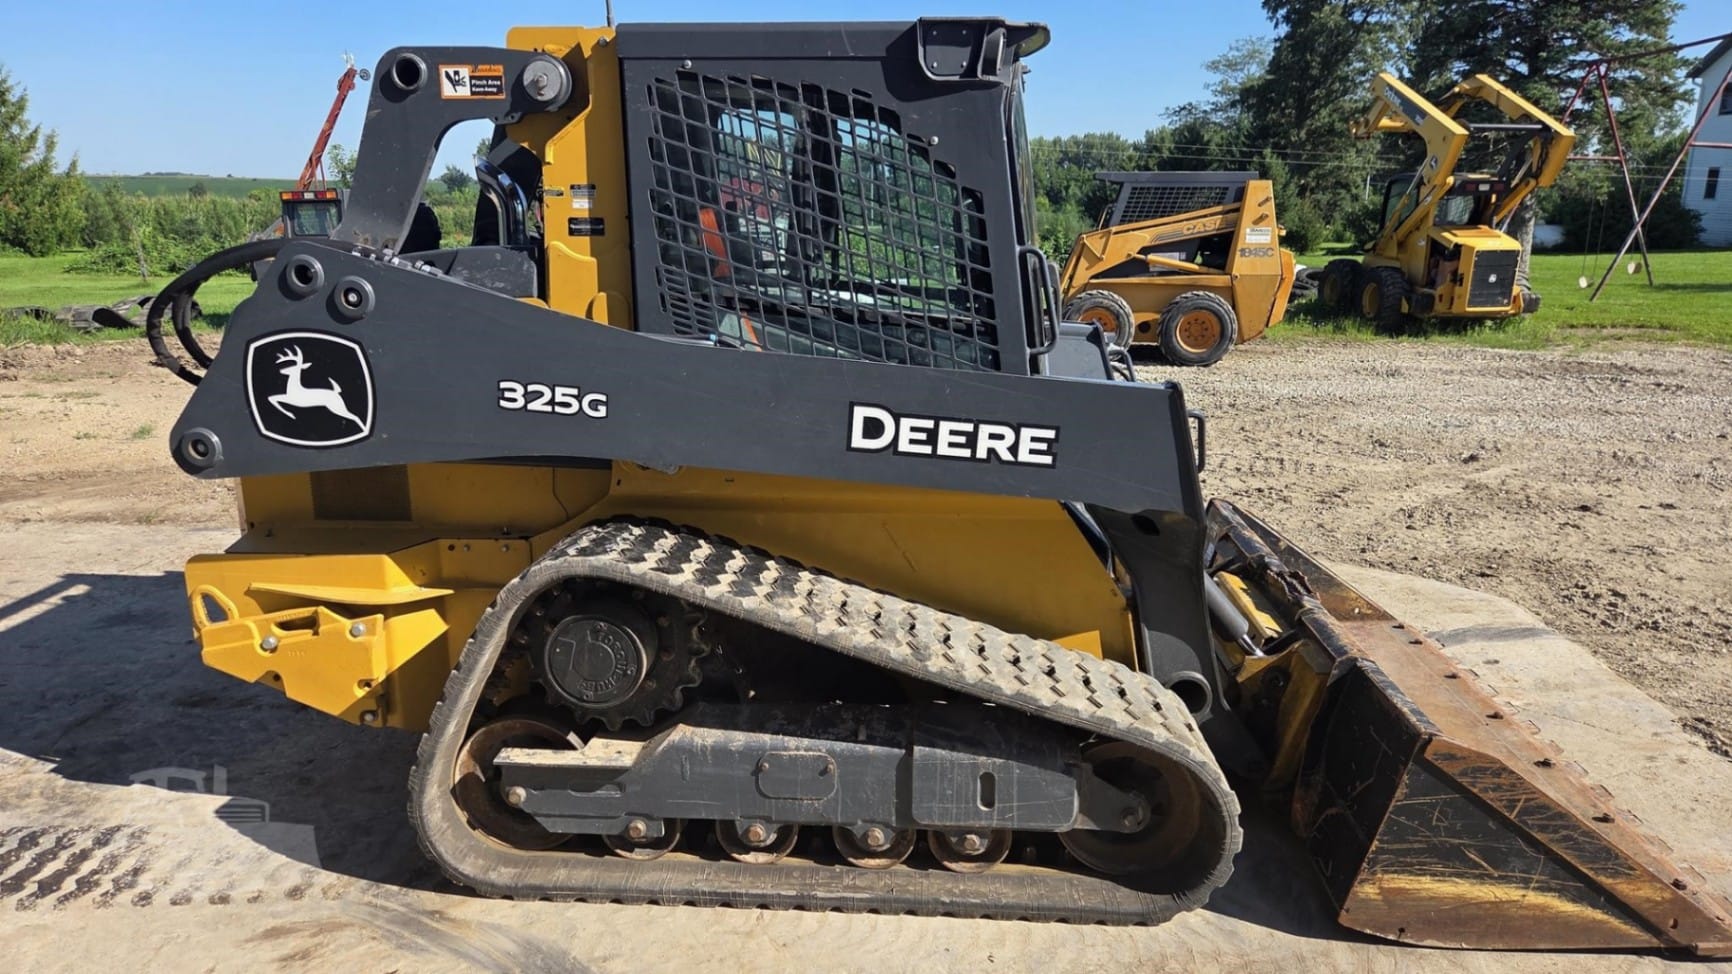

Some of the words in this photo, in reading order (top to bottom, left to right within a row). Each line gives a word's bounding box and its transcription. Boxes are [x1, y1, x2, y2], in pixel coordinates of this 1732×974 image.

[1239, 247, 1274, 258] 1845C
[499, 380, 608, 418] 325G
[850, 404, 1057, 466] DEERE
